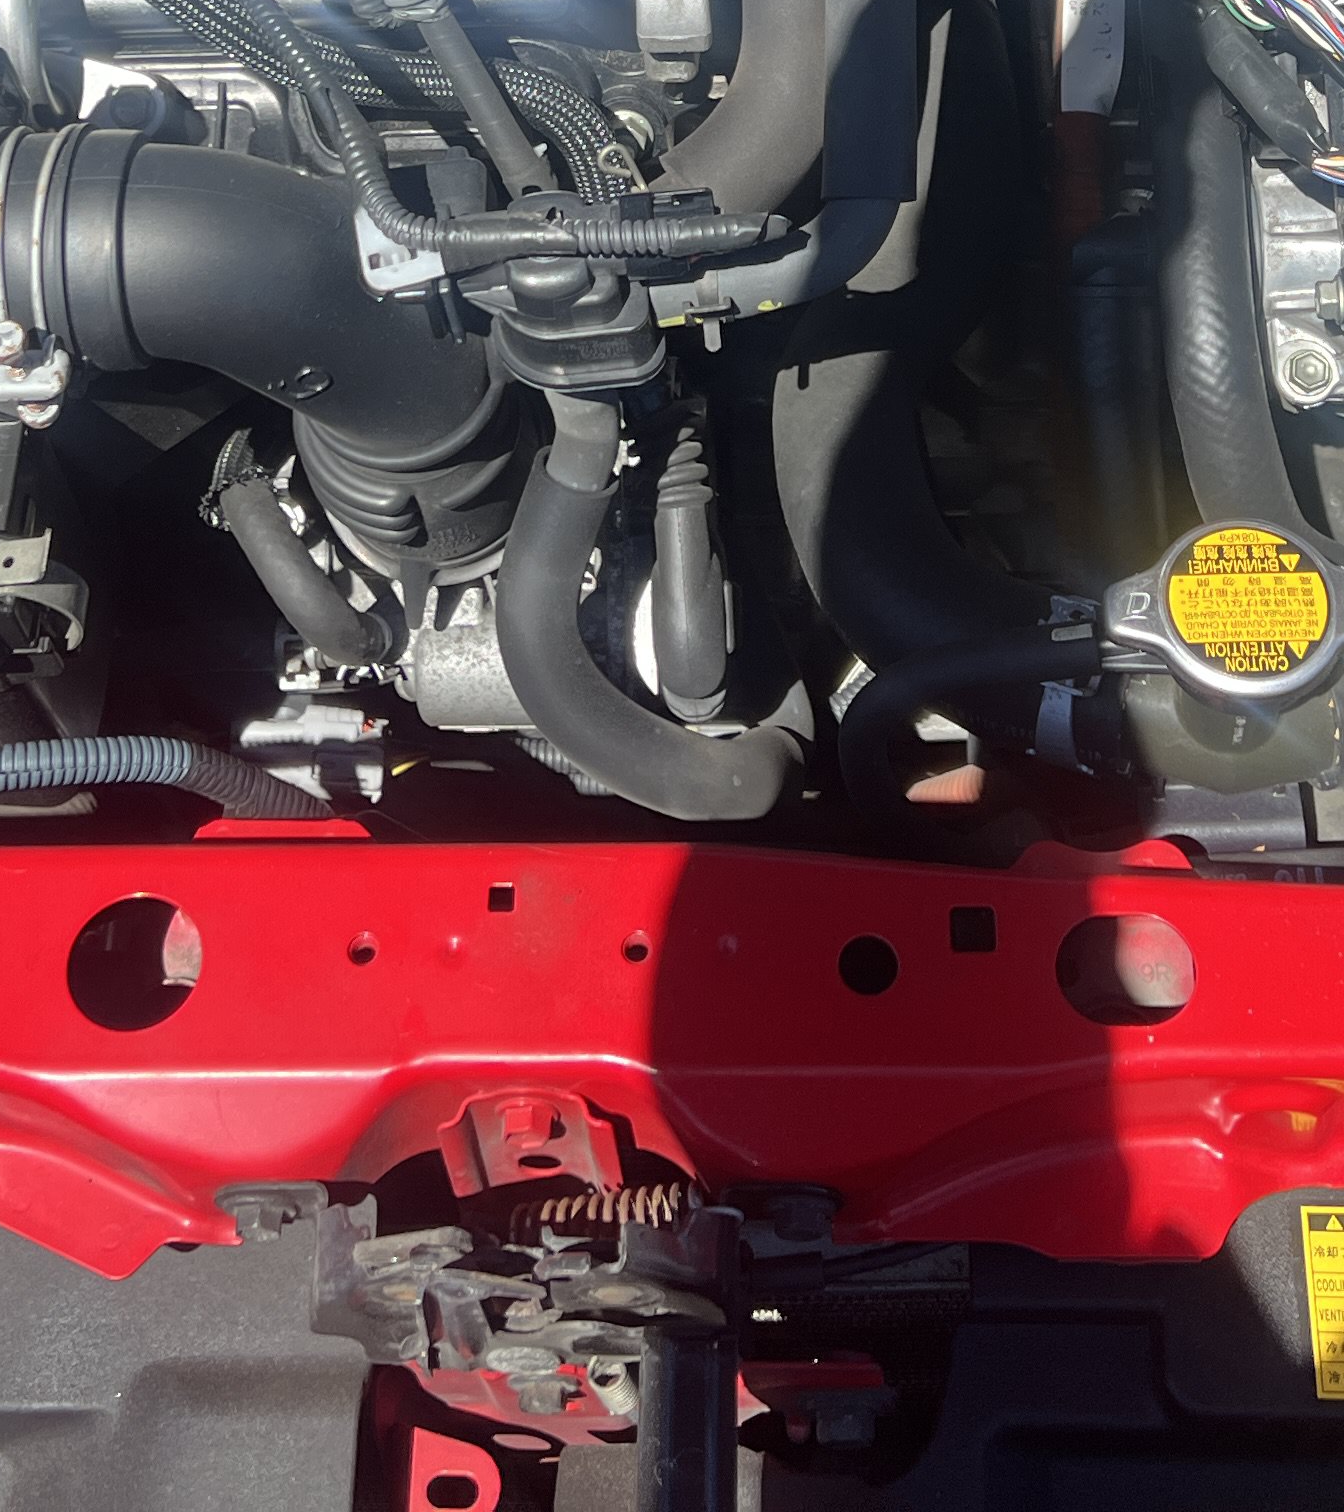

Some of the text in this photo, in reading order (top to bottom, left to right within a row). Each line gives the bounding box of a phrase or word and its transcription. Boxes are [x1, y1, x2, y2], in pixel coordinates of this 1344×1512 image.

[1188, 558, 1279, 574] ВНИМАНИЕ!
[1239, 609, 1250, 618] ДО
[1253, 609, 1302, 618] ОТКРЫВАТЬ
[1306, 609, 1316, 618] НЕ
[1231, 618, 1266, 628] OUVRIR
[1269, 619, 1302, 629] JAMAIS
[1306, 619, 1318, 629] NE
[1211, 628, 1243, 638] WHEN
[1246, 629, 1276, 639] OPEN
[1280, 629, 1315, 639] NEVER
[1204, 640, 1285, 657] ATTENTION
[1225, 655, 1289, 672] CAUTION
